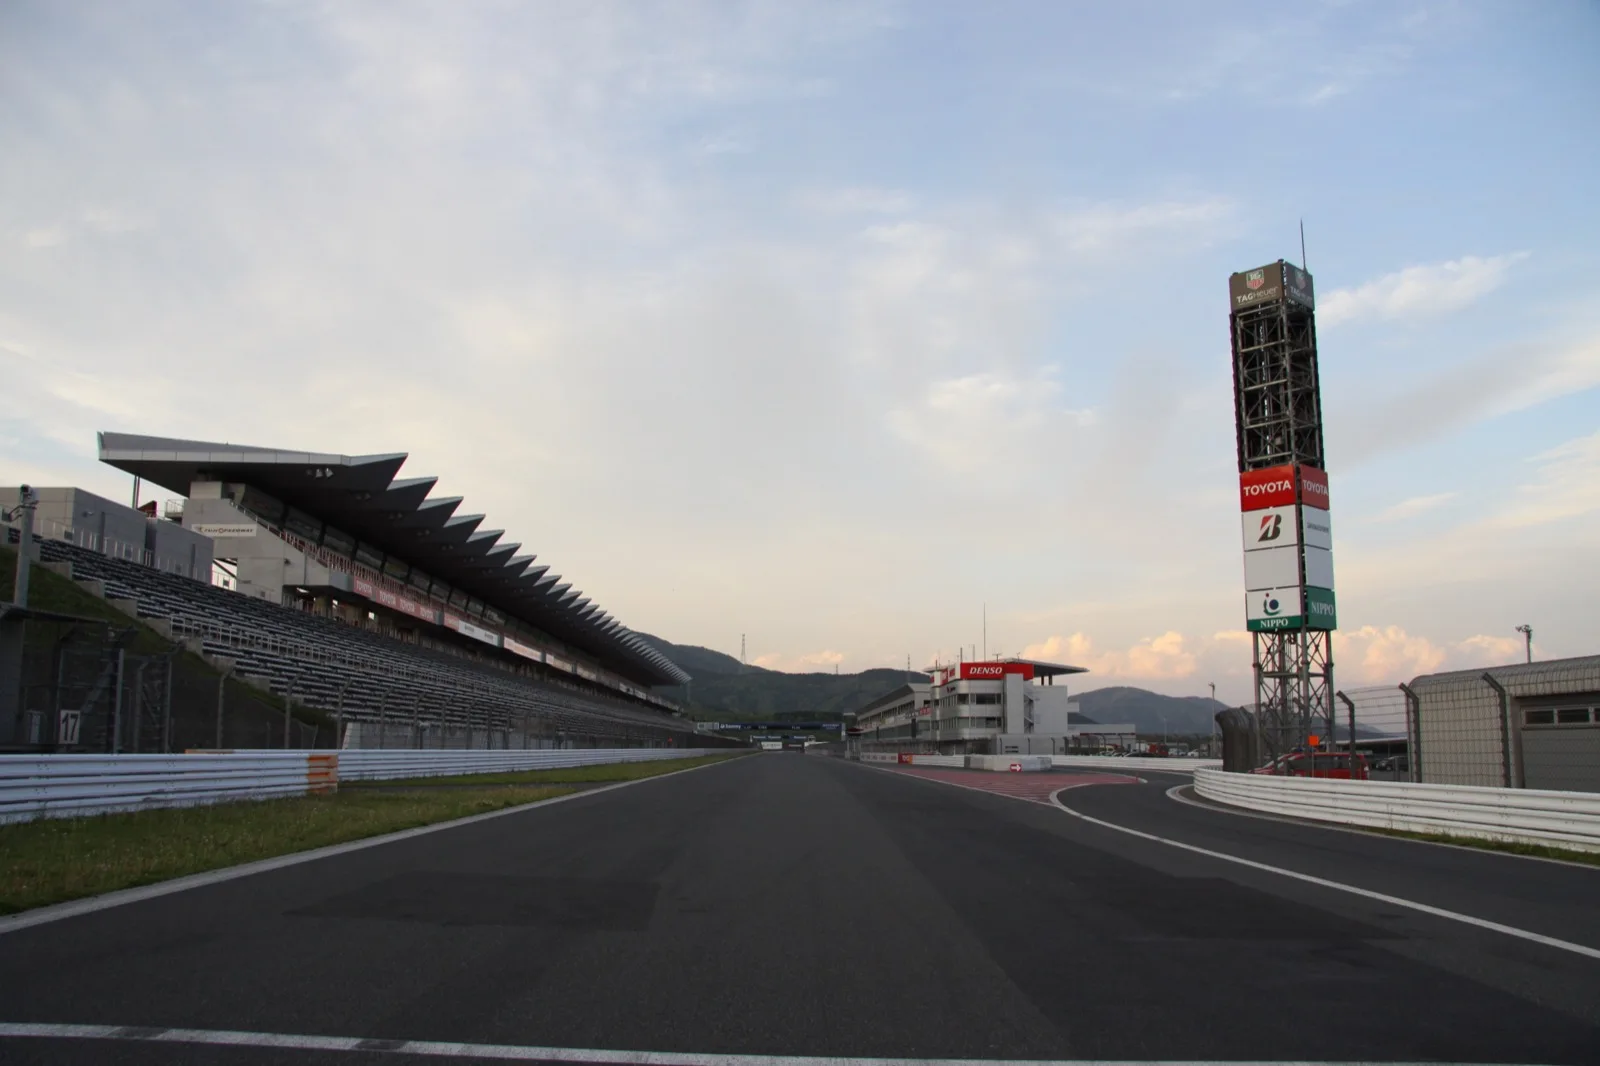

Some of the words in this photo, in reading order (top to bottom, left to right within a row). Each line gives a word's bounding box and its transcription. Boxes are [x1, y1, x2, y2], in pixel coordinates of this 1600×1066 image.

[1243, 480, 1292, 496] TOYOTA
[1302, 479, 1328, 496] TOYOTA
[1311, 601, 1334, 616] NIPPO
[1260, 618, 1289, 629] NIPPO
[969, 666, 1003, 675] DENSO
[61, 713, 79, 741] 17
